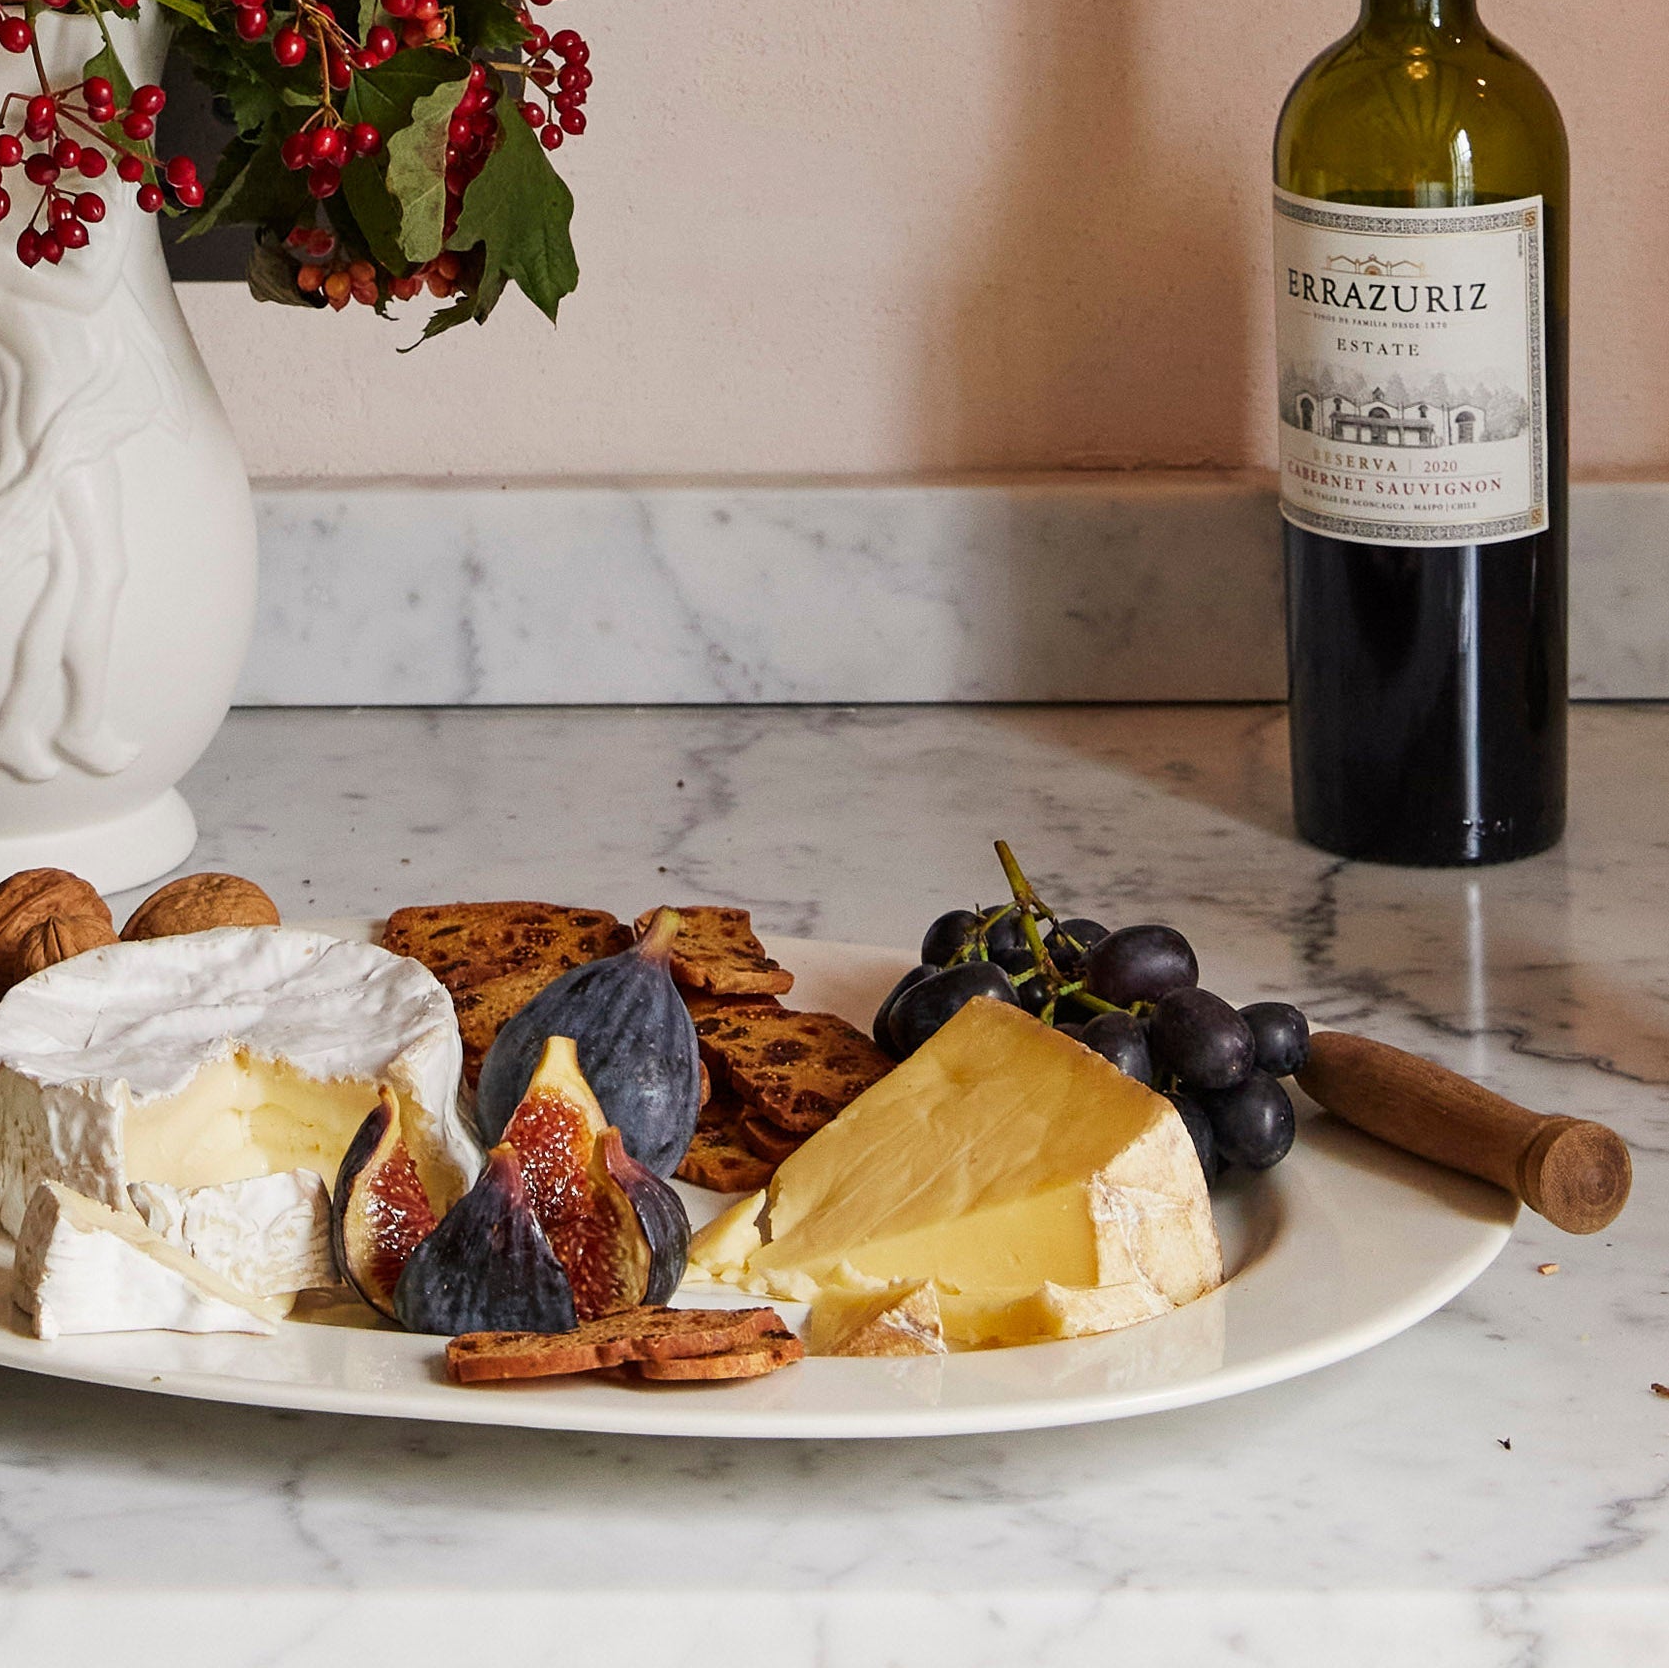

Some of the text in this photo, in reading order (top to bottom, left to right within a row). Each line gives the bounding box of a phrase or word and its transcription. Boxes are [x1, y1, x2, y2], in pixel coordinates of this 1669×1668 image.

[1287, 267, 1488, 313] ERRAZURIZ
[1337, 337, 1420, 357] ESTATE
[1311, 446, 1458, 474] RESERVA 2020
[1287, 459, 1502, 496] CABERNET SAUVIGNON
